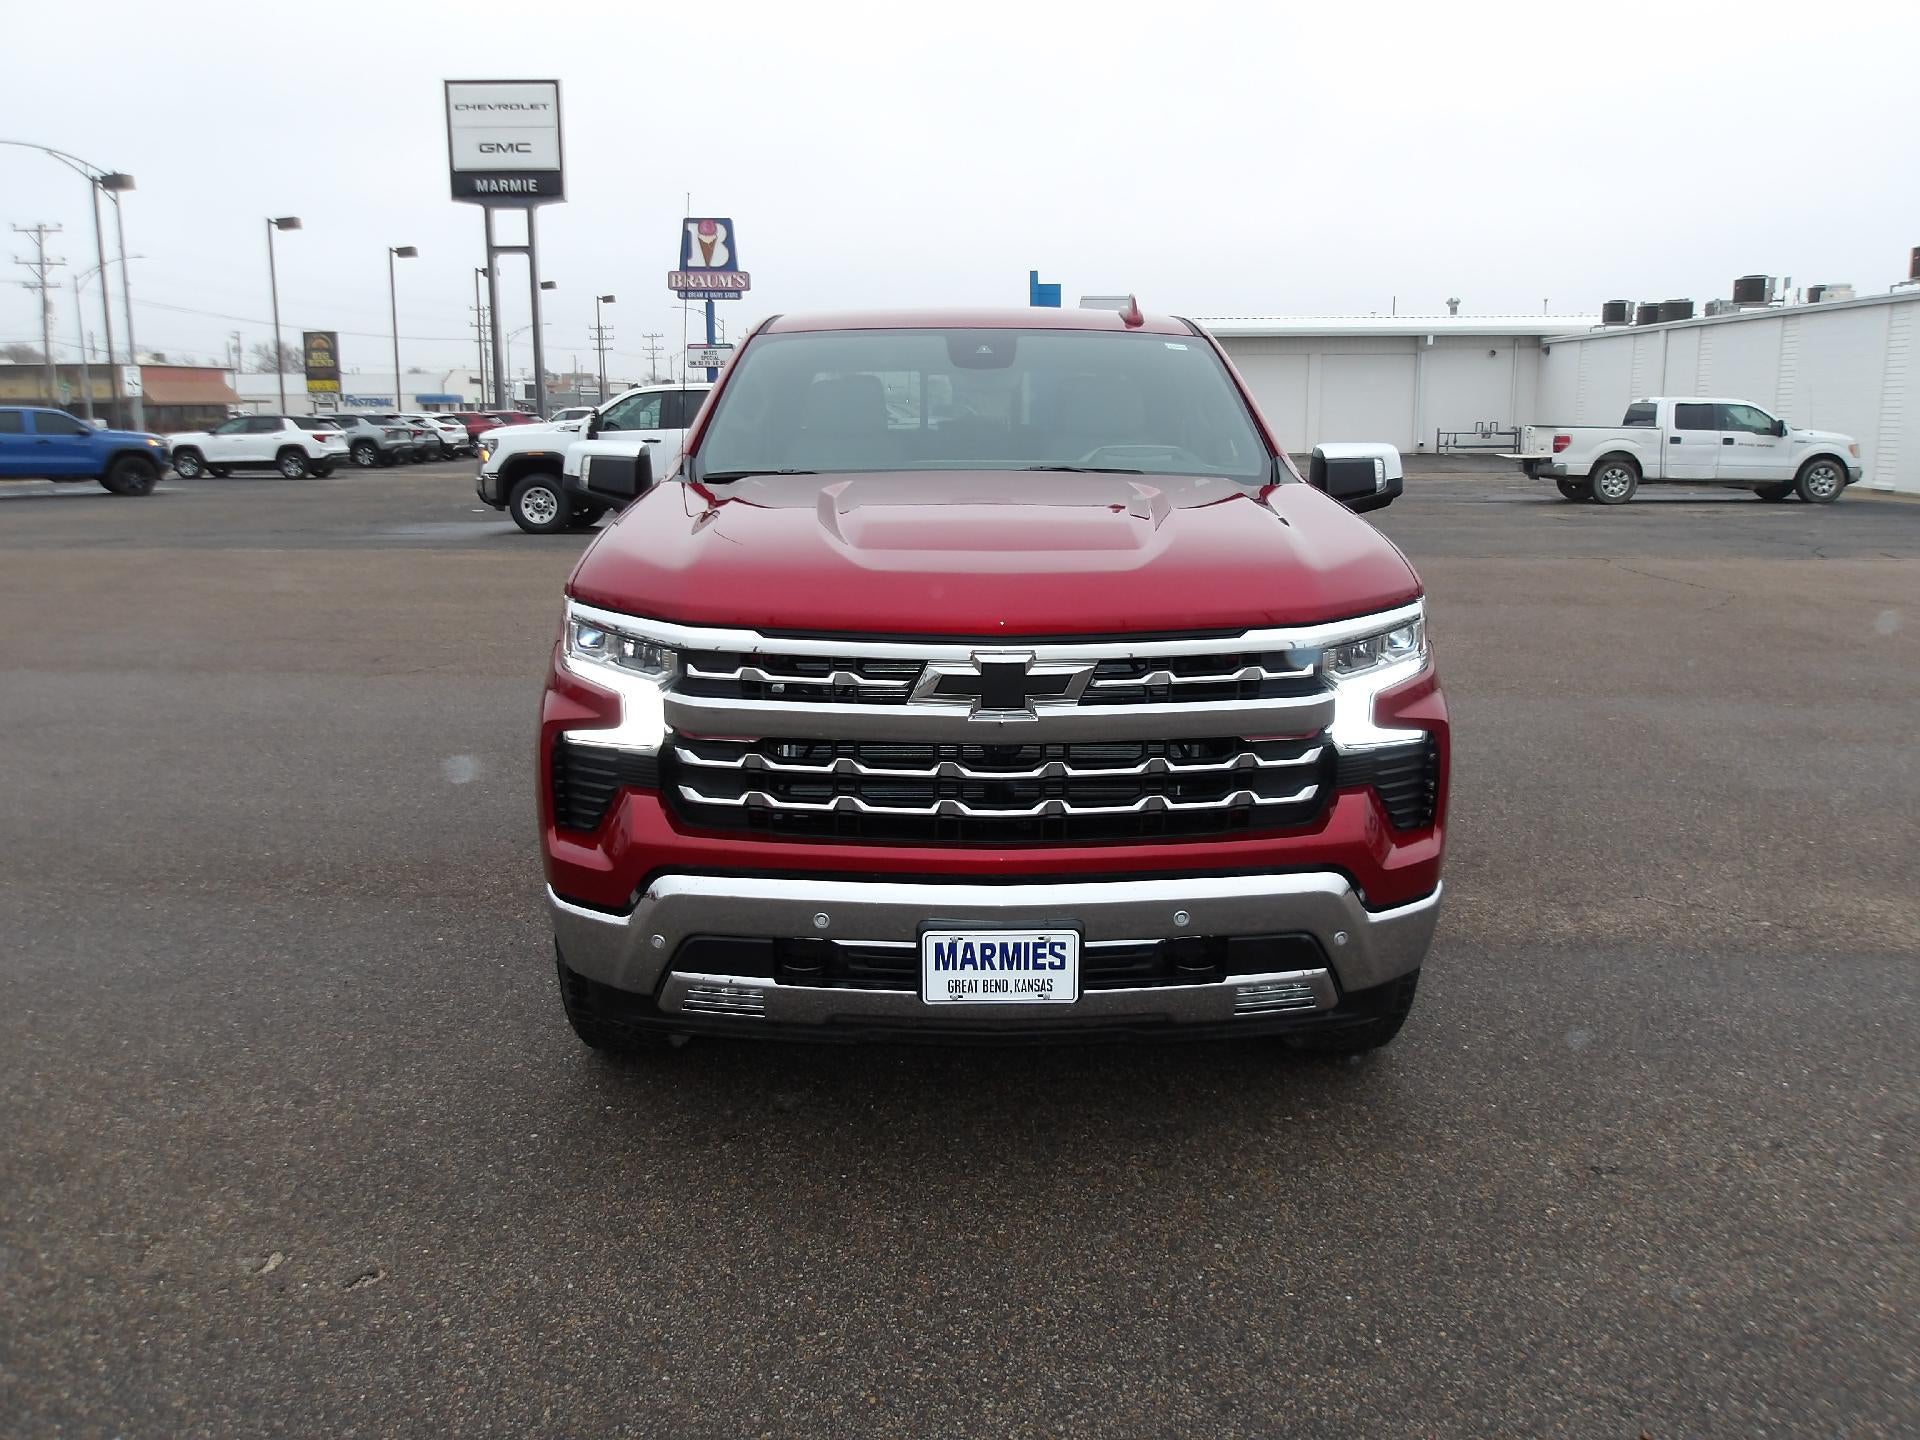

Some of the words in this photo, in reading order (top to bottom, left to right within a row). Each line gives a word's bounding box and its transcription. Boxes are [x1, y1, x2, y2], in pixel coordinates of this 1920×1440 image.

[479, 143, 532, 153] GMC
[476, 180, 538, 192] MARMIE
[672, 274, 746, 288] BRAUM'S
[935, 942, 1067, 971] MARMIES
[947, 979, 979, 993] GREAT
[982, 979, 1013, 994] BEND,
[1014, 979, 1054, 993] KANSAS
